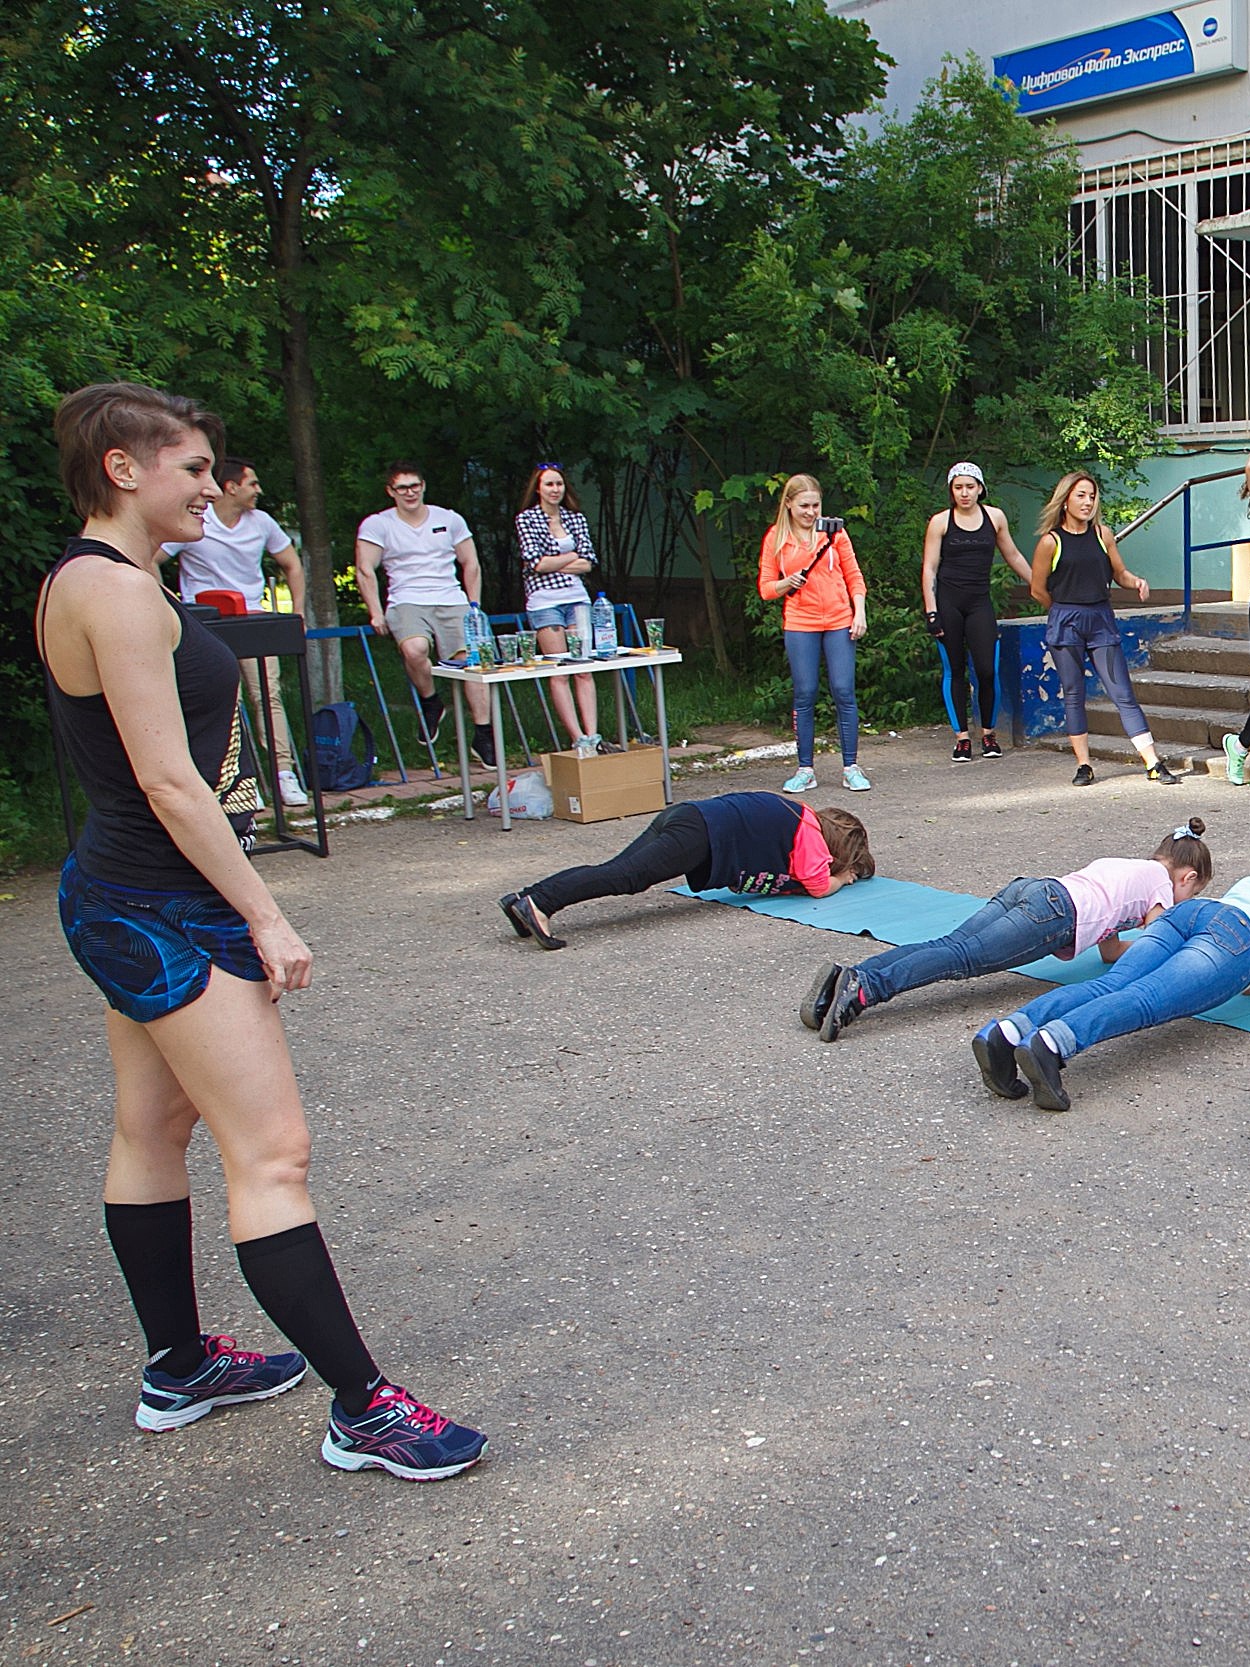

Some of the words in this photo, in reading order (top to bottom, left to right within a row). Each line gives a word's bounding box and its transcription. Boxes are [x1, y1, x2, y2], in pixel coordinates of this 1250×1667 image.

[1021, 61, 1084, 92] Цифровой
[1084, 54, 1122, 74] Фото
[1123, 38, 1186, 66] Экспресс
